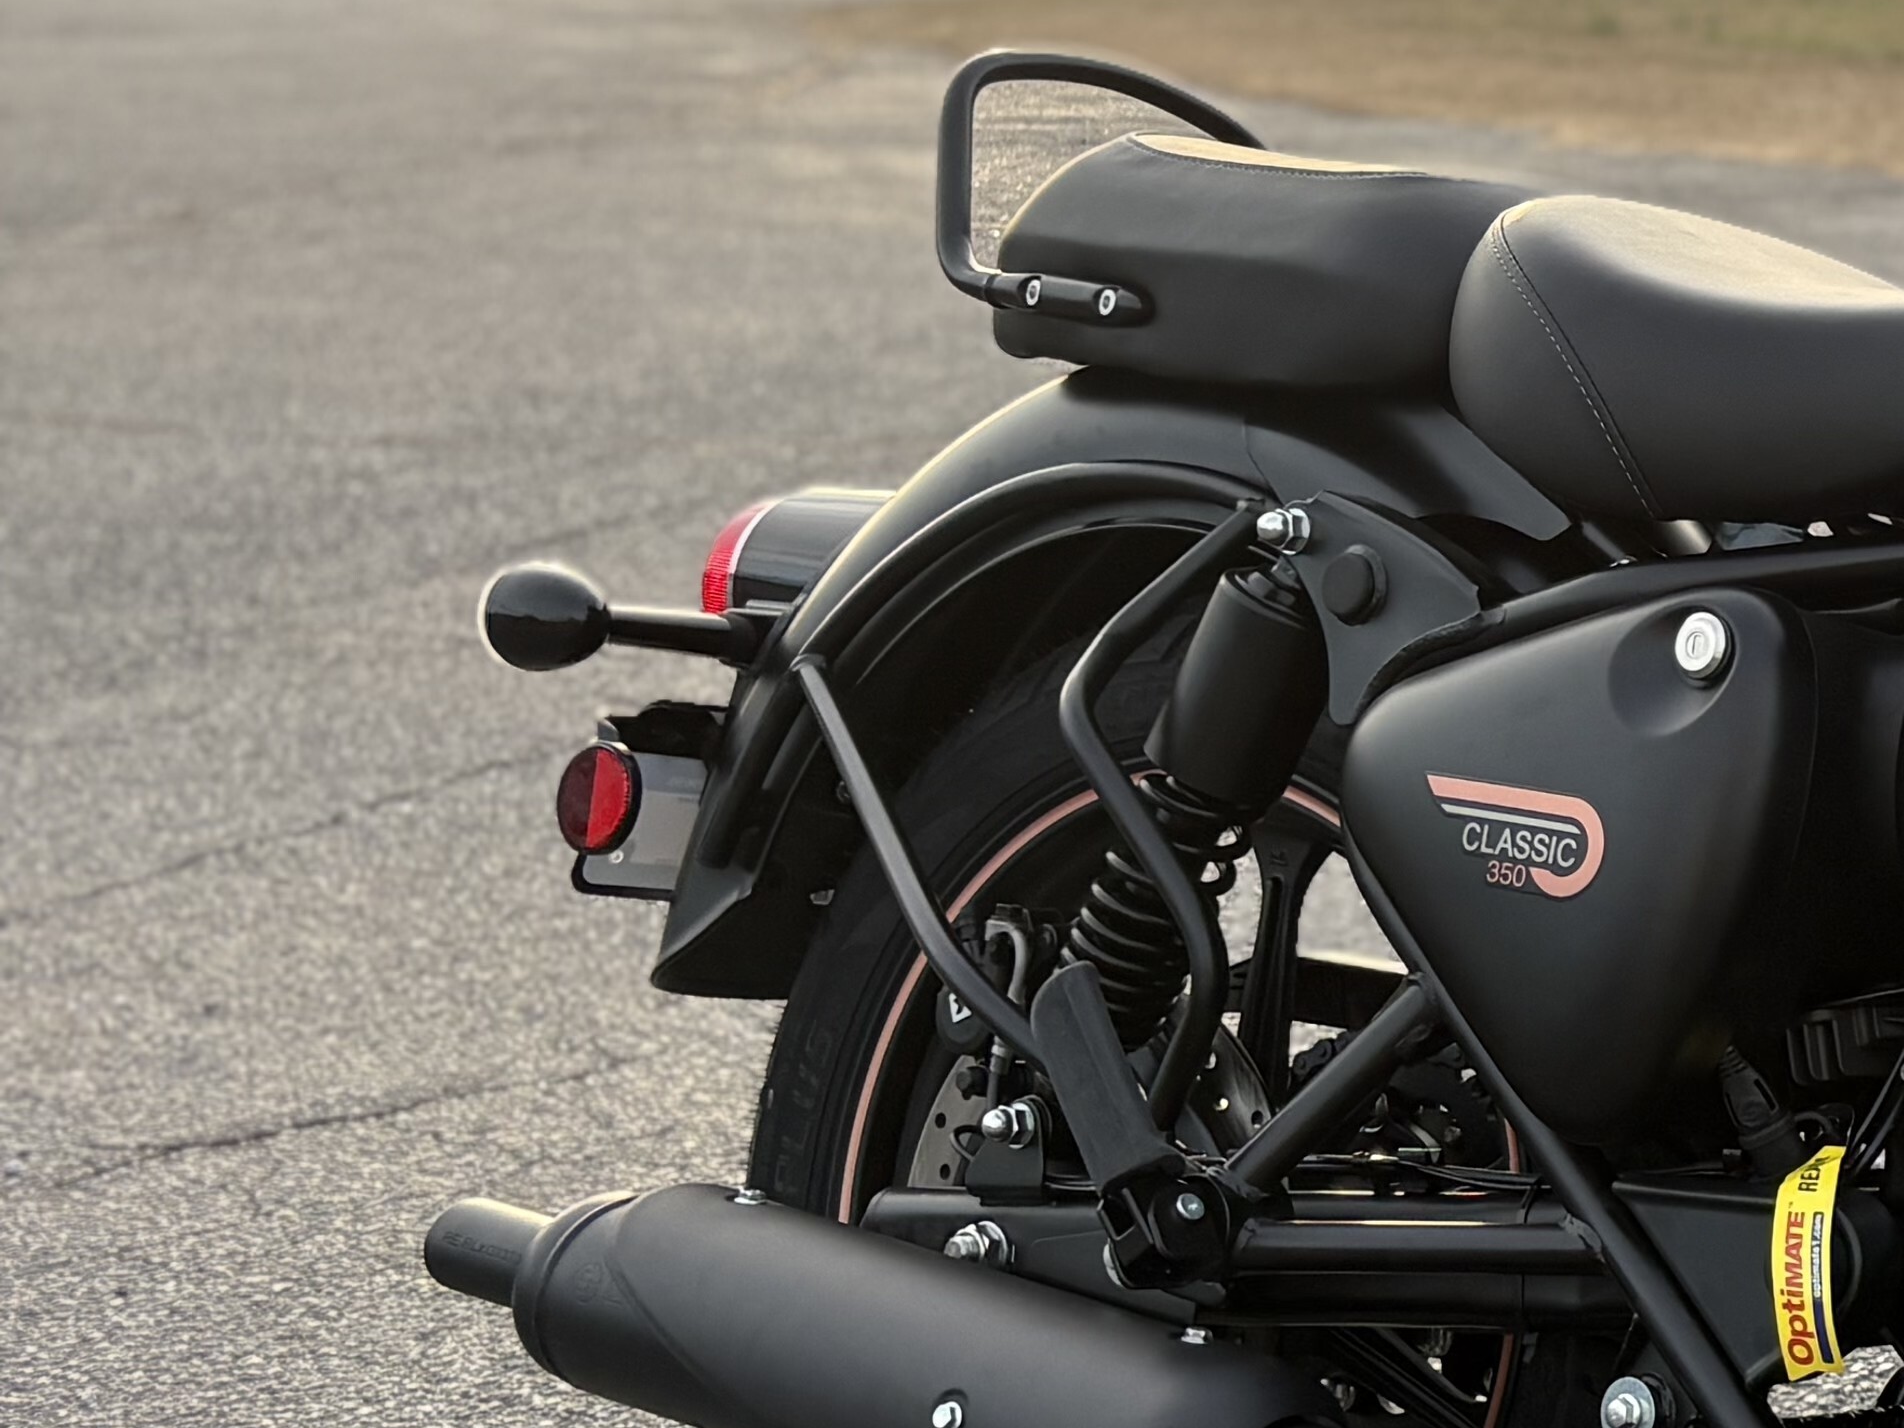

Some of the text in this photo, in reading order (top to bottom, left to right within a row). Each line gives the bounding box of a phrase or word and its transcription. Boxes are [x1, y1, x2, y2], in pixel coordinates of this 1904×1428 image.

[1462, 822, 1578, 868] CLASSIC
[1486, 860, 1526, 888] 350
[1782, 1211, 1815, 1366] OptiMATE
